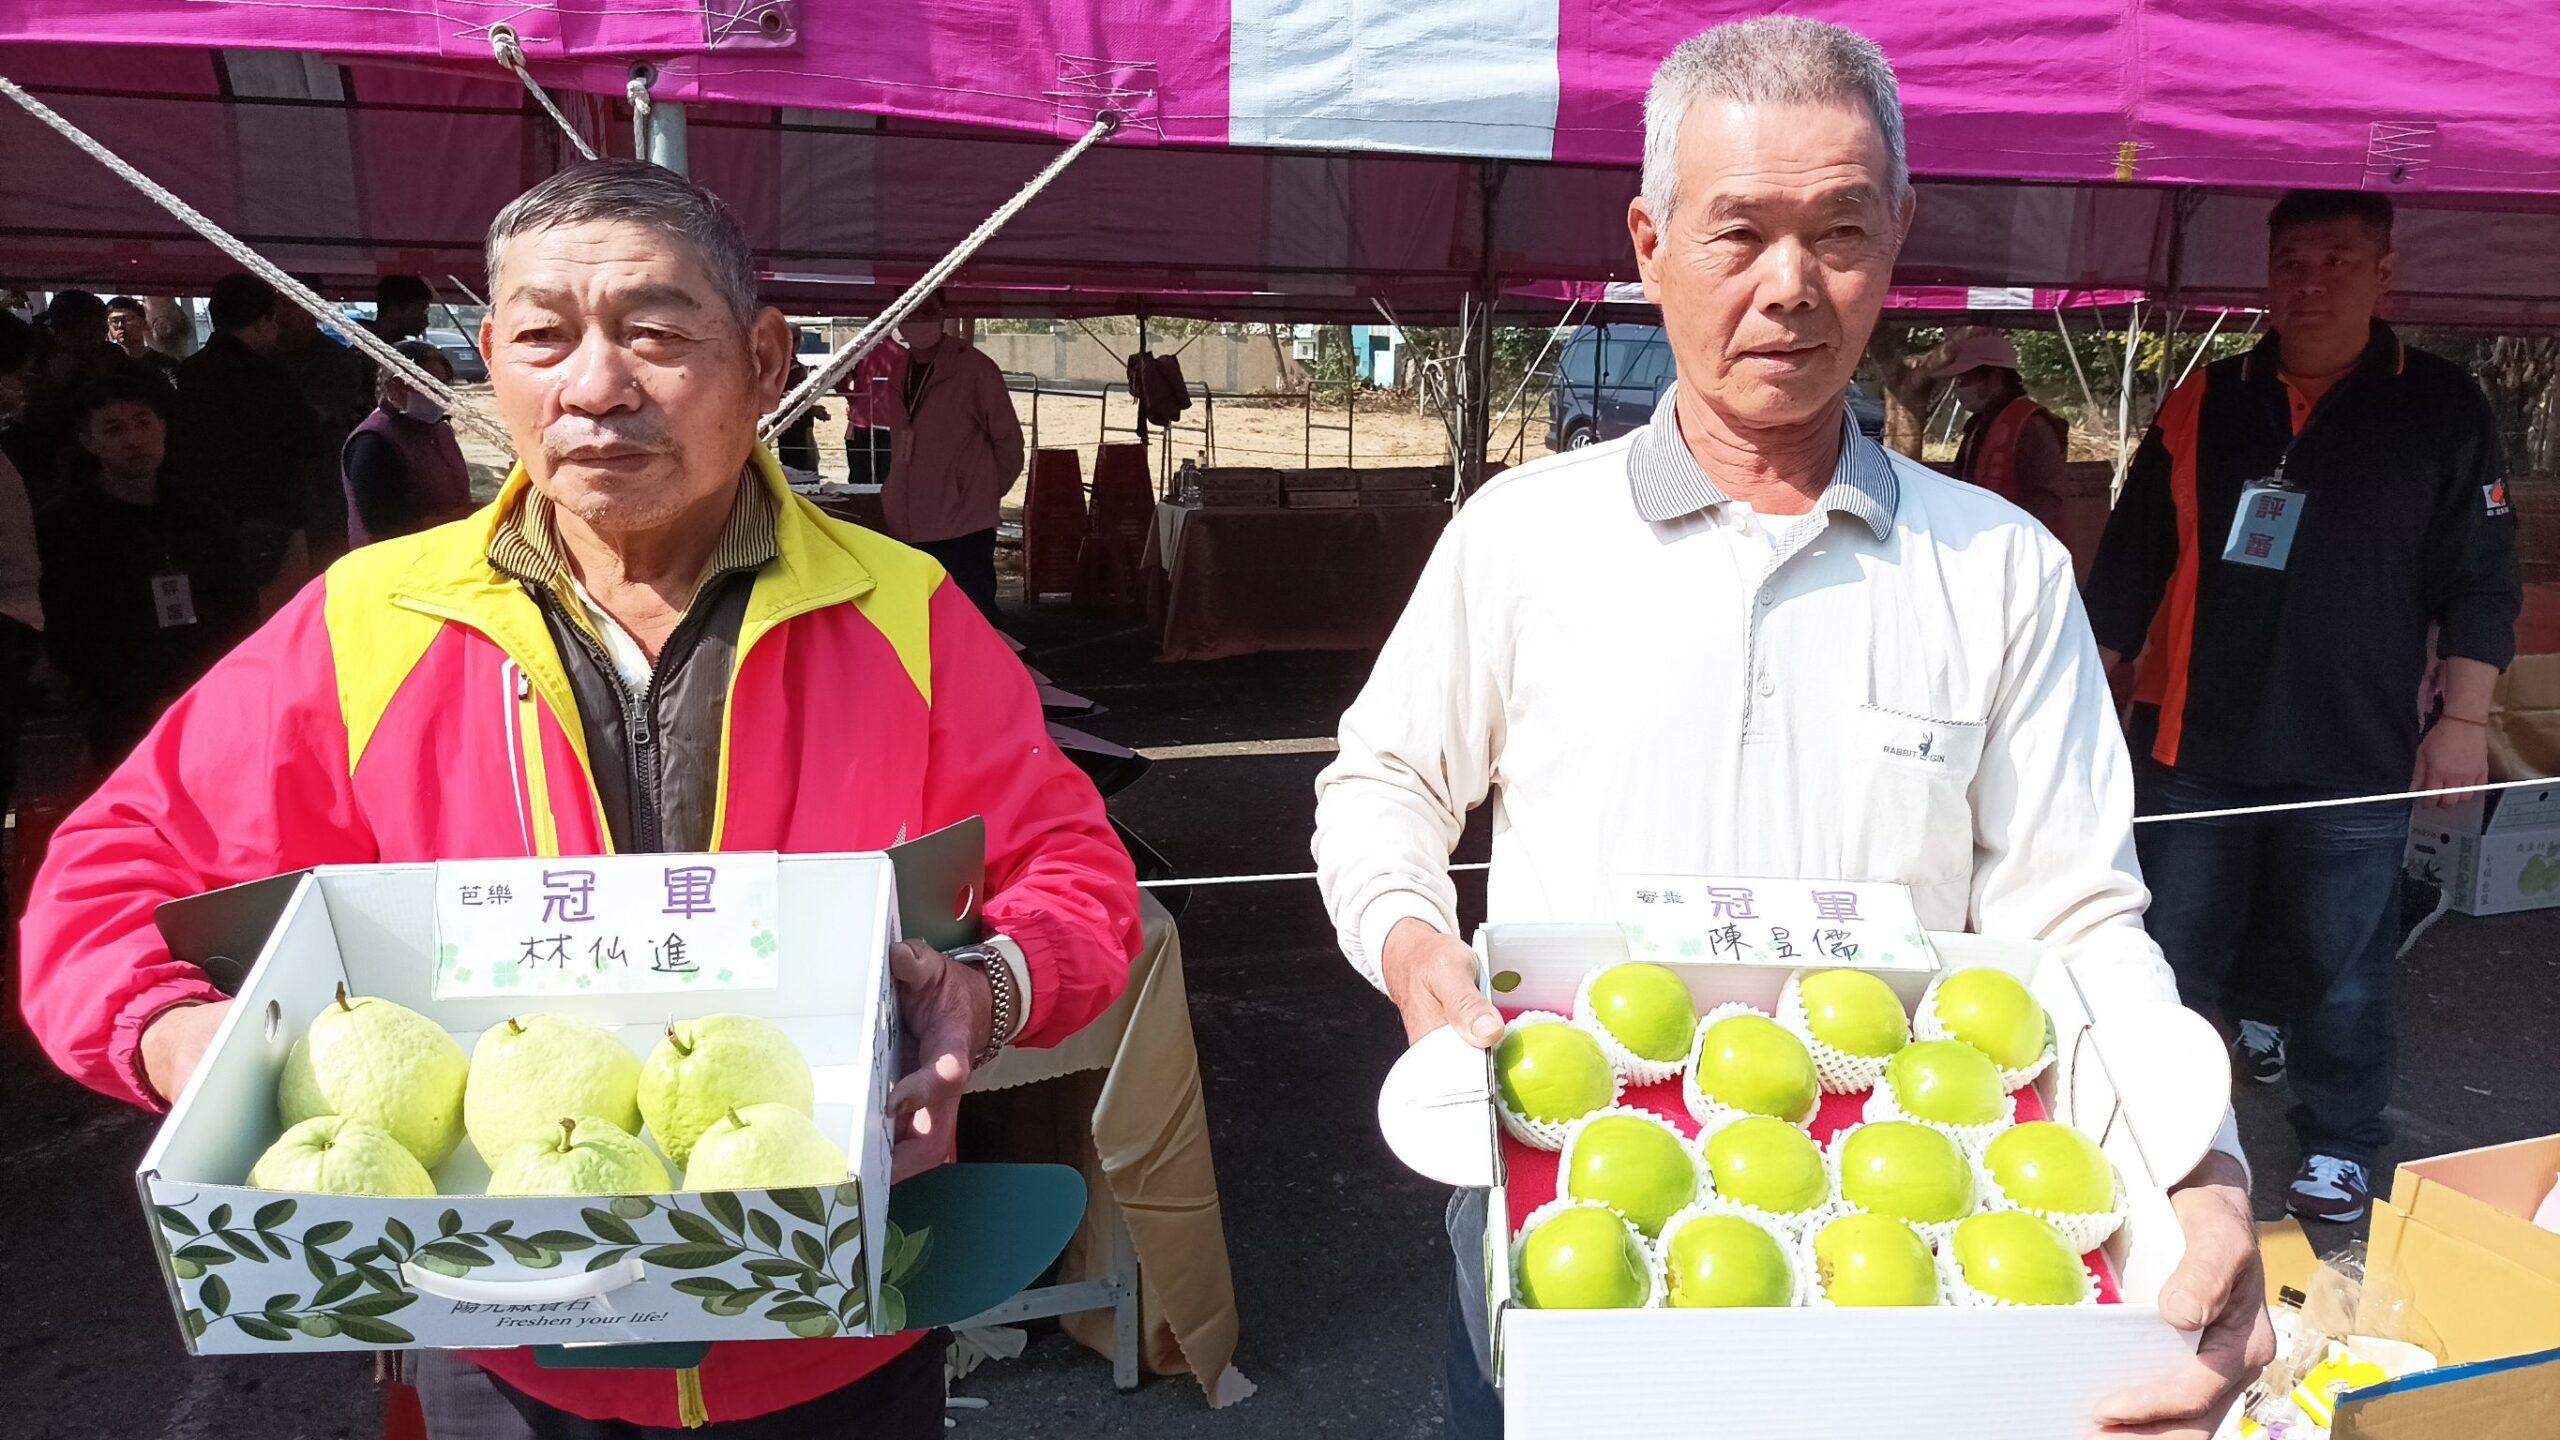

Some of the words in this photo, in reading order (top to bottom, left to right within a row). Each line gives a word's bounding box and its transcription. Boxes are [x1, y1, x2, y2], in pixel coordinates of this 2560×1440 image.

[2244, 495, 2287, 559] 評審
[1883, 745, 1918, 758] RABBIT
[459, 884, 513, 906] 芭樂
[541, 866, 717, 924] 冠軍
[1706, 885, 1865, 924] 冠軍
[517, 932, 701, 973] 林仙進
[496, 1316, 572, 1328] Freshen
[575, 1314, 626, 1328] your
[629, 1311, 669, 1324] life!
